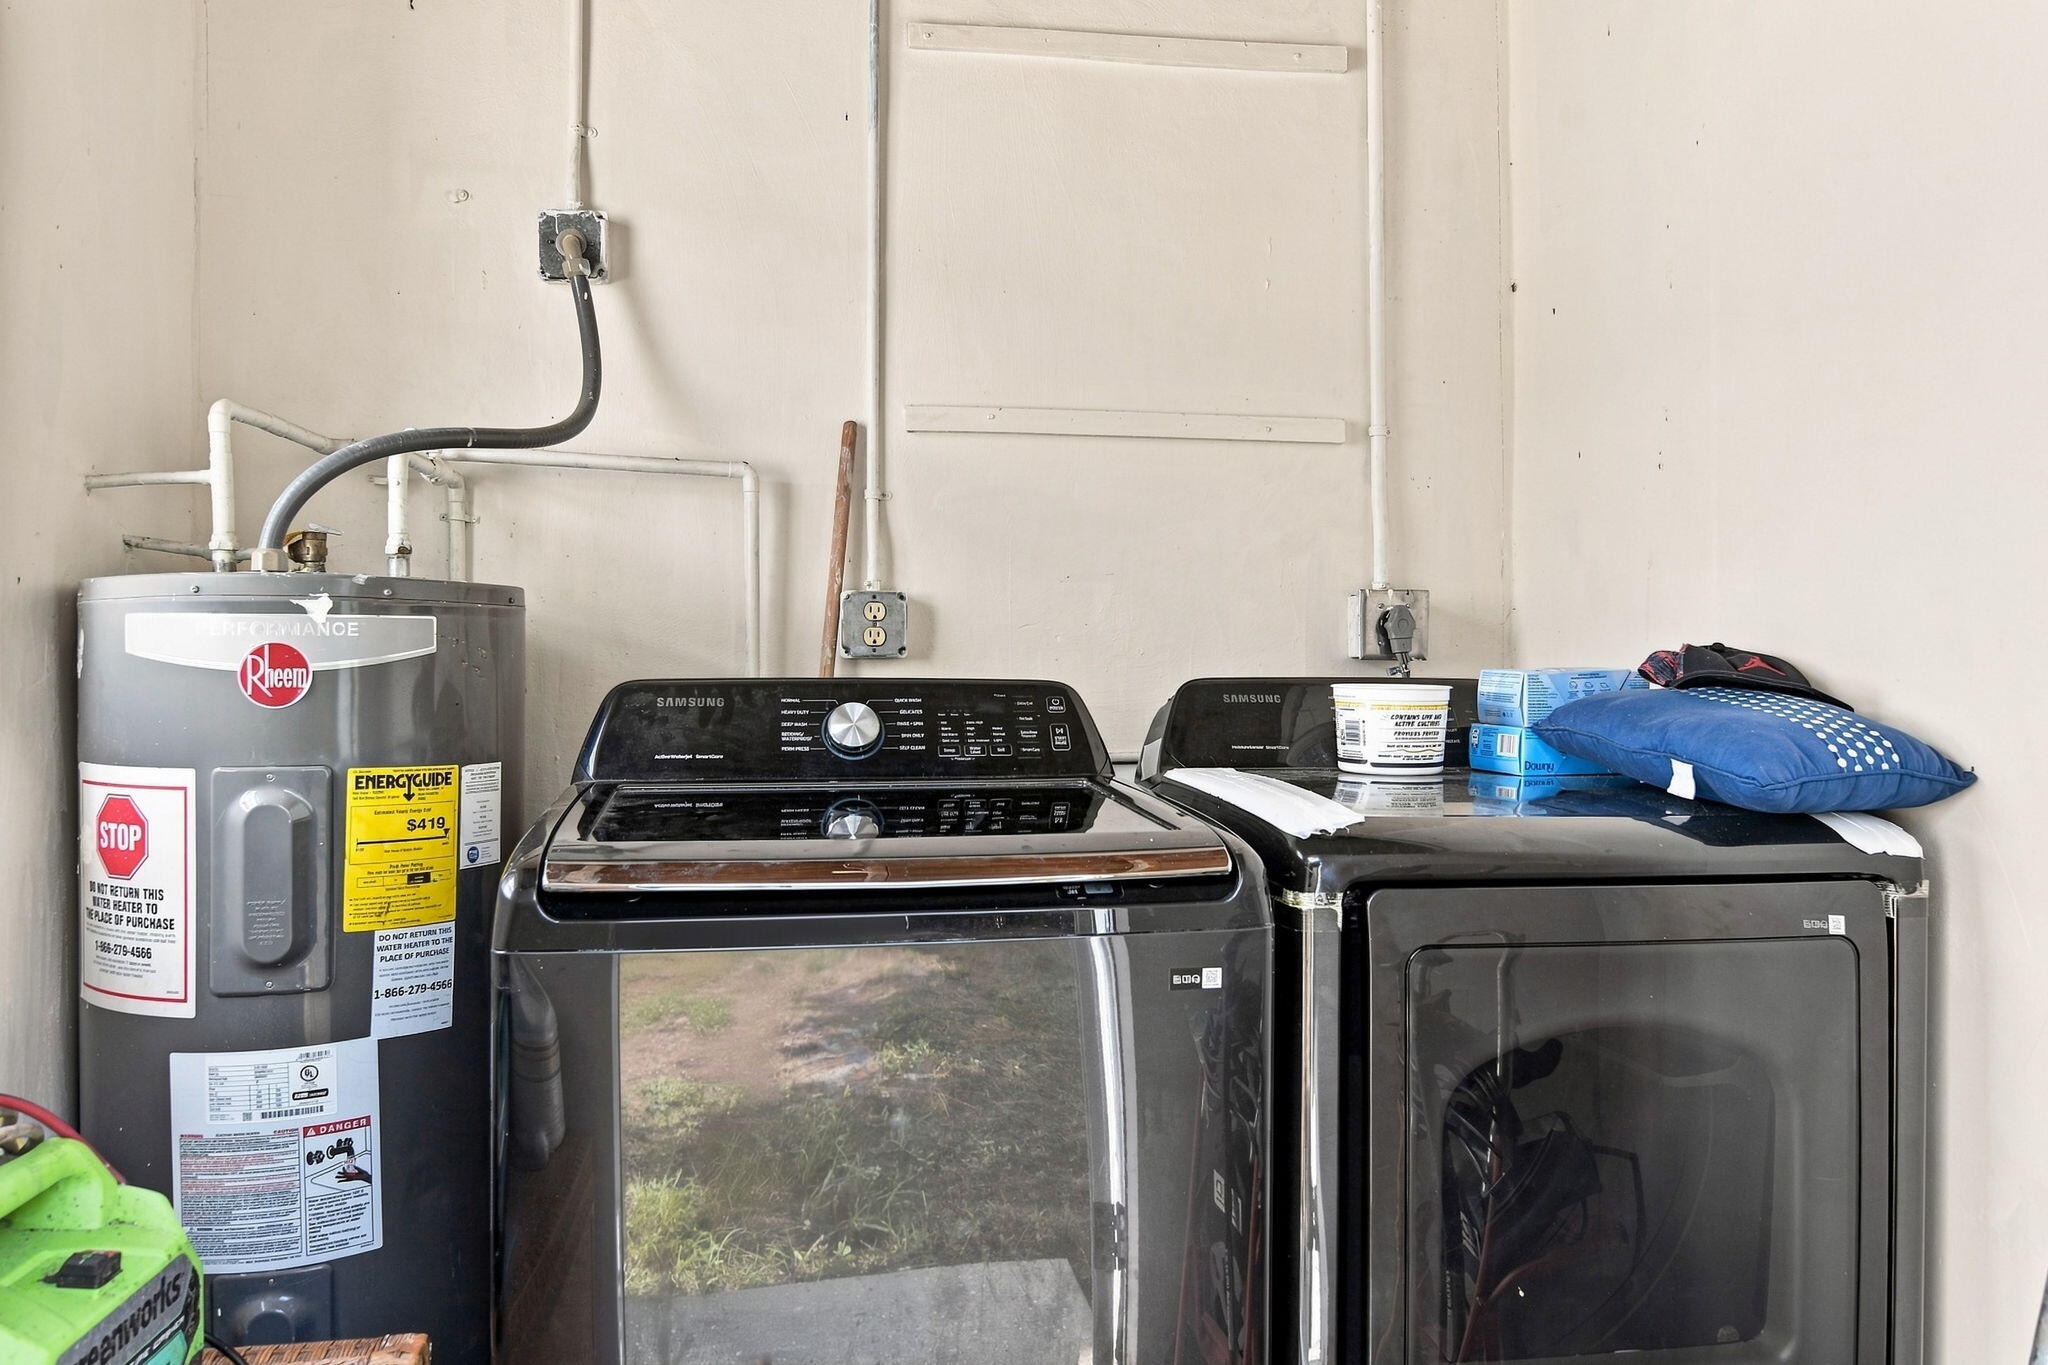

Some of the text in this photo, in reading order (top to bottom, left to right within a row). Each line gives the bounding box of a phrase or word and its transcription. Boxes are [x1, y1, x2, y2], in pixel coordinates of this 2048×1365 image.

[194, 621, 359, 637] PERFORMANCE
[246, 644, 308, 697] Rheem
[656, 697, 725, 707] SAMSUNG
[1223, 694, 1281, 703] SAMSUNG
[1524, 760, 1555, 773] Downy
[355, 772, 452, 790] ENERGYGUIDE
[406, 816, 445, 832] $419
[100, 821, 142, 852] STOP
[89, 881, 164, 901] DO NOT RETURN THIS
[92, 895, 158, 915] WATER HEATER TO
[94, 910, 113, 925] PLACE
[114, 914, 124, 926] OF
[126, 915, 175, 930] PURCHASE
[379, 927, 452, 942] DO NOT RETURN THIS
[94, 940, 152, 960] 1-866-279-4566
[376, 943, 402, 952] WATER
[404, 940, 430, 950] HEATER
[431, 938, 441, 946] TO
[380, 947, 450, 963] PLACE OF PURCHASE
[374, 979, 453, 1000] 1-866-279-4566
[319, 1118, 367, 1135] DANGER
